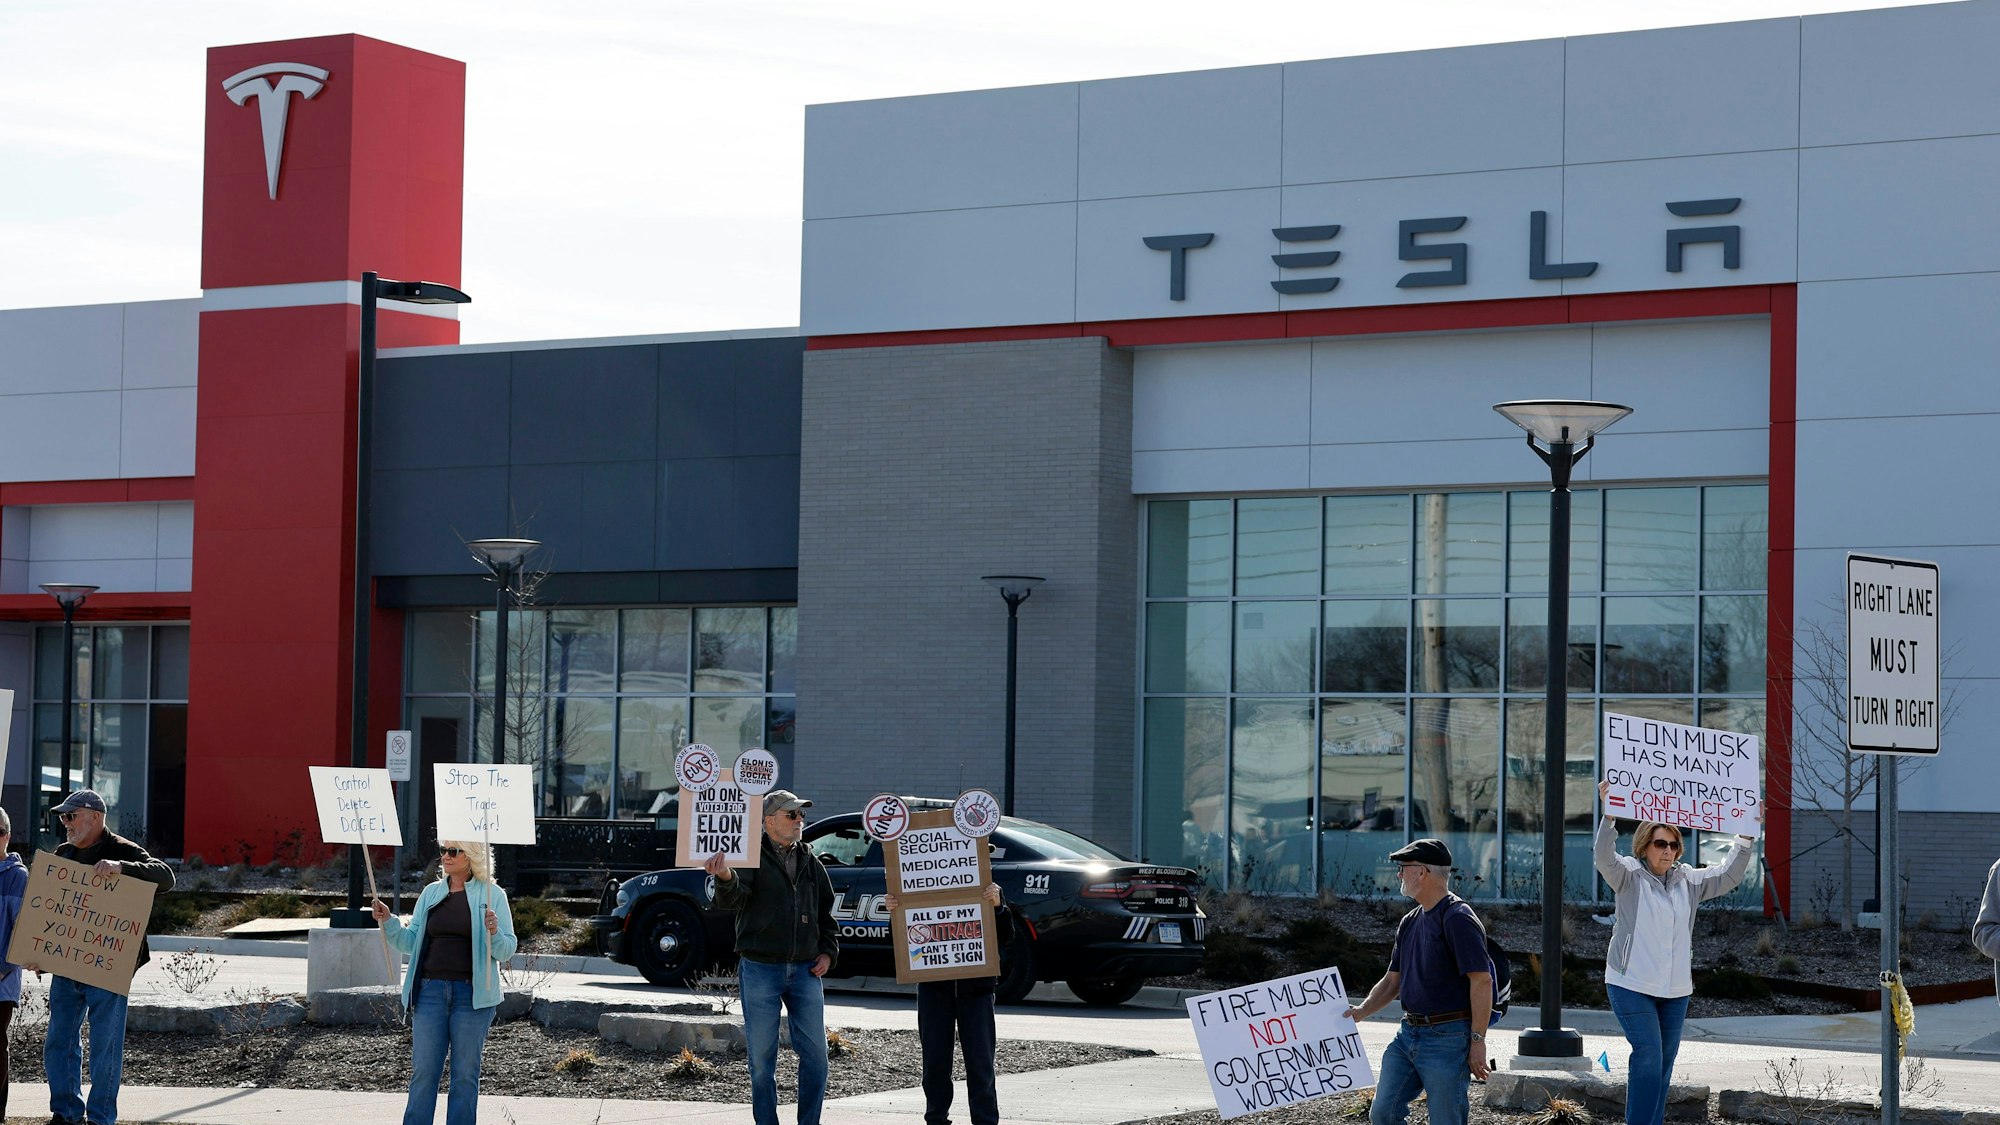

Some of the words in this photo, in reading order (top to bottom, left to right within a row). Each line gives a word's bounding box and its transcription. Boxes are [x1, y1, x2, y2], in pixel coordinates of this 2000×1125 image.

[1142, 198, 1742, 301] TESLA
[1854, 582, 1893, 612] RIGHT
[1898, 586, 1933, 616] LANE
[1870, 637, 1918, 674] MUST
[1853, 696, 1888, 725] TURN
[1895, 698, 1934, 728] RIGHT
[1609, 716, 1678, 749] ELON
[1685, 729, 1750, 760] MUSK
[675, 749, 688, 778] MEDICARE
[694, 744, 718, 763] MEDICAID
[685, 755, 710, 779] CUTS
[740, 764, 774, 774] STEALING
[741, 758, 764, 766] ELON
[1622, 744, 1667, 768] HAS
[1673, 753, 1734, 778] MANY
[334, 774, 371, 791] Control
[444, 768, 479, 790] Stop
[487, 768, 510, 787] The
[740, 771, 773, 781] SOCIAL
[740, 777, 772, 786] SECURITY
[698, 787, 716, 801] NO
[720, 787, 745, 802] ONE
[1606, 768, 1645, 790] GOV.
[1650, 775, 1757, 807] CONTRACTS
[336, 796, 372, 812] Delete
[465, 796, 497, 811] Trade
[699, 802, 726, 812] VOTED
[727, 803, 744, 813] FOR
[1630, 790, 1725, 818] CONFLICT
[1730, 808, 1747, 819] OF
[469, 814, 500, 831] War!
[697, 814, 743, 834] ELON
[872, 796, 899, 840] KINGS
[1634, 804, 1726, 832] INTEREST
[696, 834, 742, 854] MUSK
[899, 831, 952, 845] SOCIAL
[900, 839, 971, 855] SECURITY
[901, 856, 977, 873] MEDICARE
[1138, 867, 1156, 875] WEST
[46, 864, 120, 892] FOLLOW
[641, 875, 659, 886] 318
[903, 873, 974, 890] MEDICAID
[1025, 874, 1050, 889] 911
[60, 888, 94, 908] THE
[1023, 887, 1050, 895] EMERGENCY
[831, 892, 890, 922] LIC
[1154, 897, 1175, 905] POLICE
[1178, 896, 1189, 908] 318
[30, 896, 141, 936] CONSTITUTION
[912, 912, 932, 922] ALL
[937, 910, 952, 920] OF
[956, 908, 975, 918] MY
[43, 920, 77, 939] YOU
[83, 930, 125, 953] DAMN
[32, 936, 114, 971] TRAITORS
[921, 944, 948, 954] CAN'T
[951, 943, 965, 952] FIT
[968, 941, 982, 950] ON
[922, 953, 949, 966] THIS
[954, 951, 983, 963] SIGN
[1197, 989, 1266, 1027] FIRE
[1267, 973, 1342, 1012] MUSK!
[1248, 1013, 1298, 1049] NOT
[1214, 1032, 1362, 1087] GOVERNMENT
[1235, 1064, 1353, 1112] WORKERS
